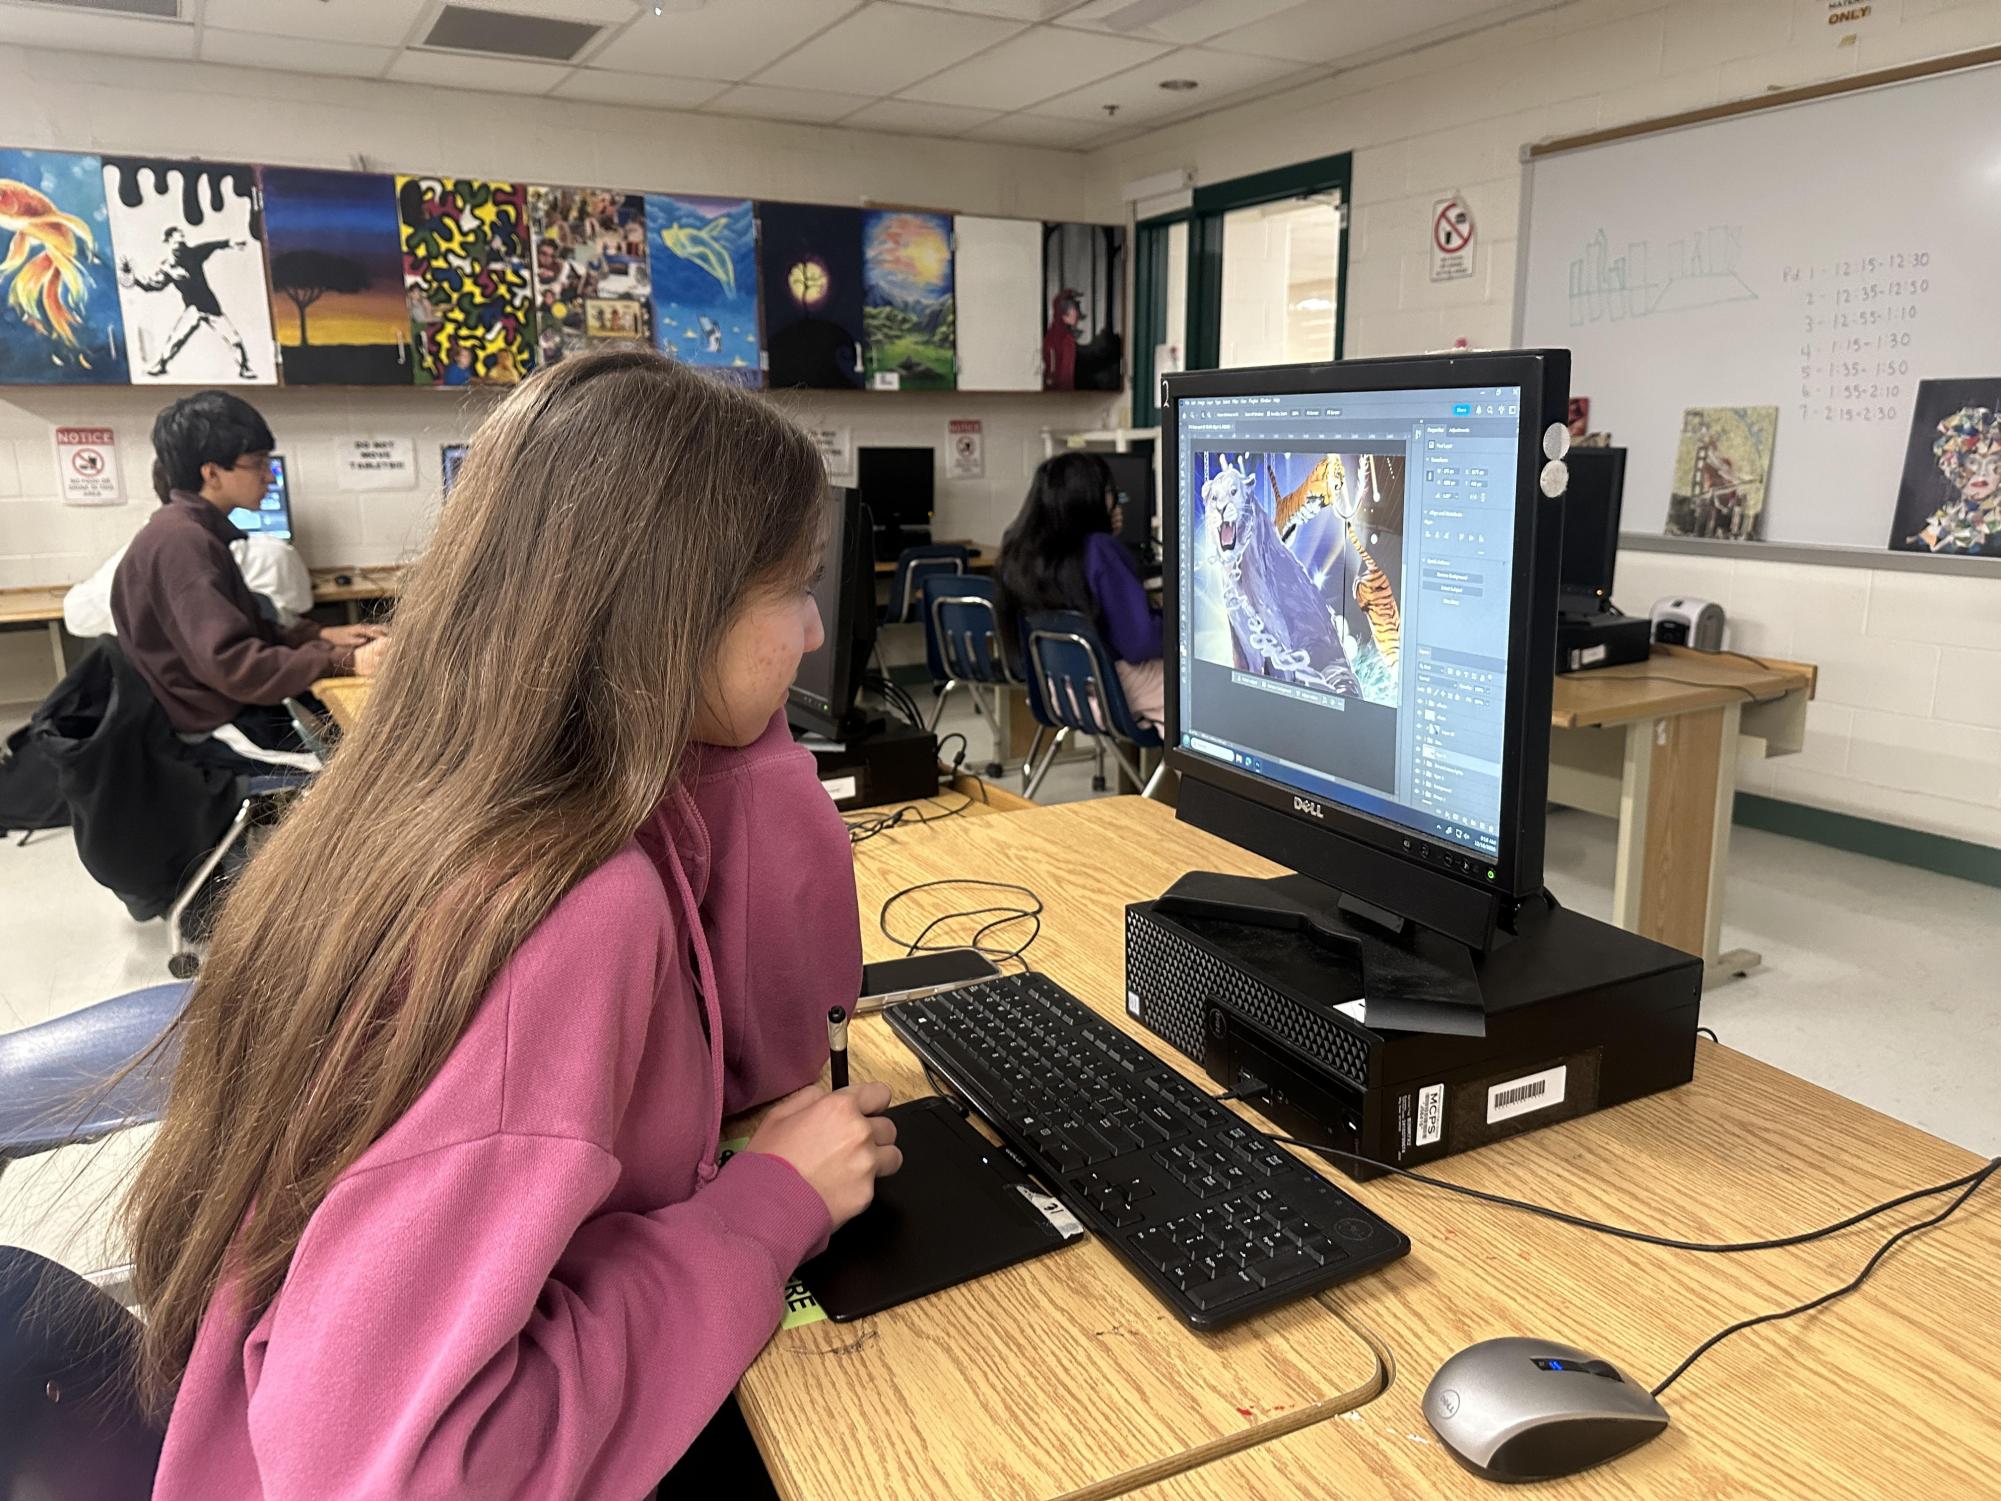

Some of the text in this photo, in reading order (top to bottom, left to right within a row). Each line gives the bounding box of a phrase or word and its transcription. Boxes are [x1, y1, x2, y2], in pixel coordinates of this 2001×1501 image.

[1829, 5, 1871, 25] ONLY
[58, 431, 112, 443] NOTICE
[1294, 796, 1324, 819] DELL
[1427, 1092, 1438, 1135] MCPS
